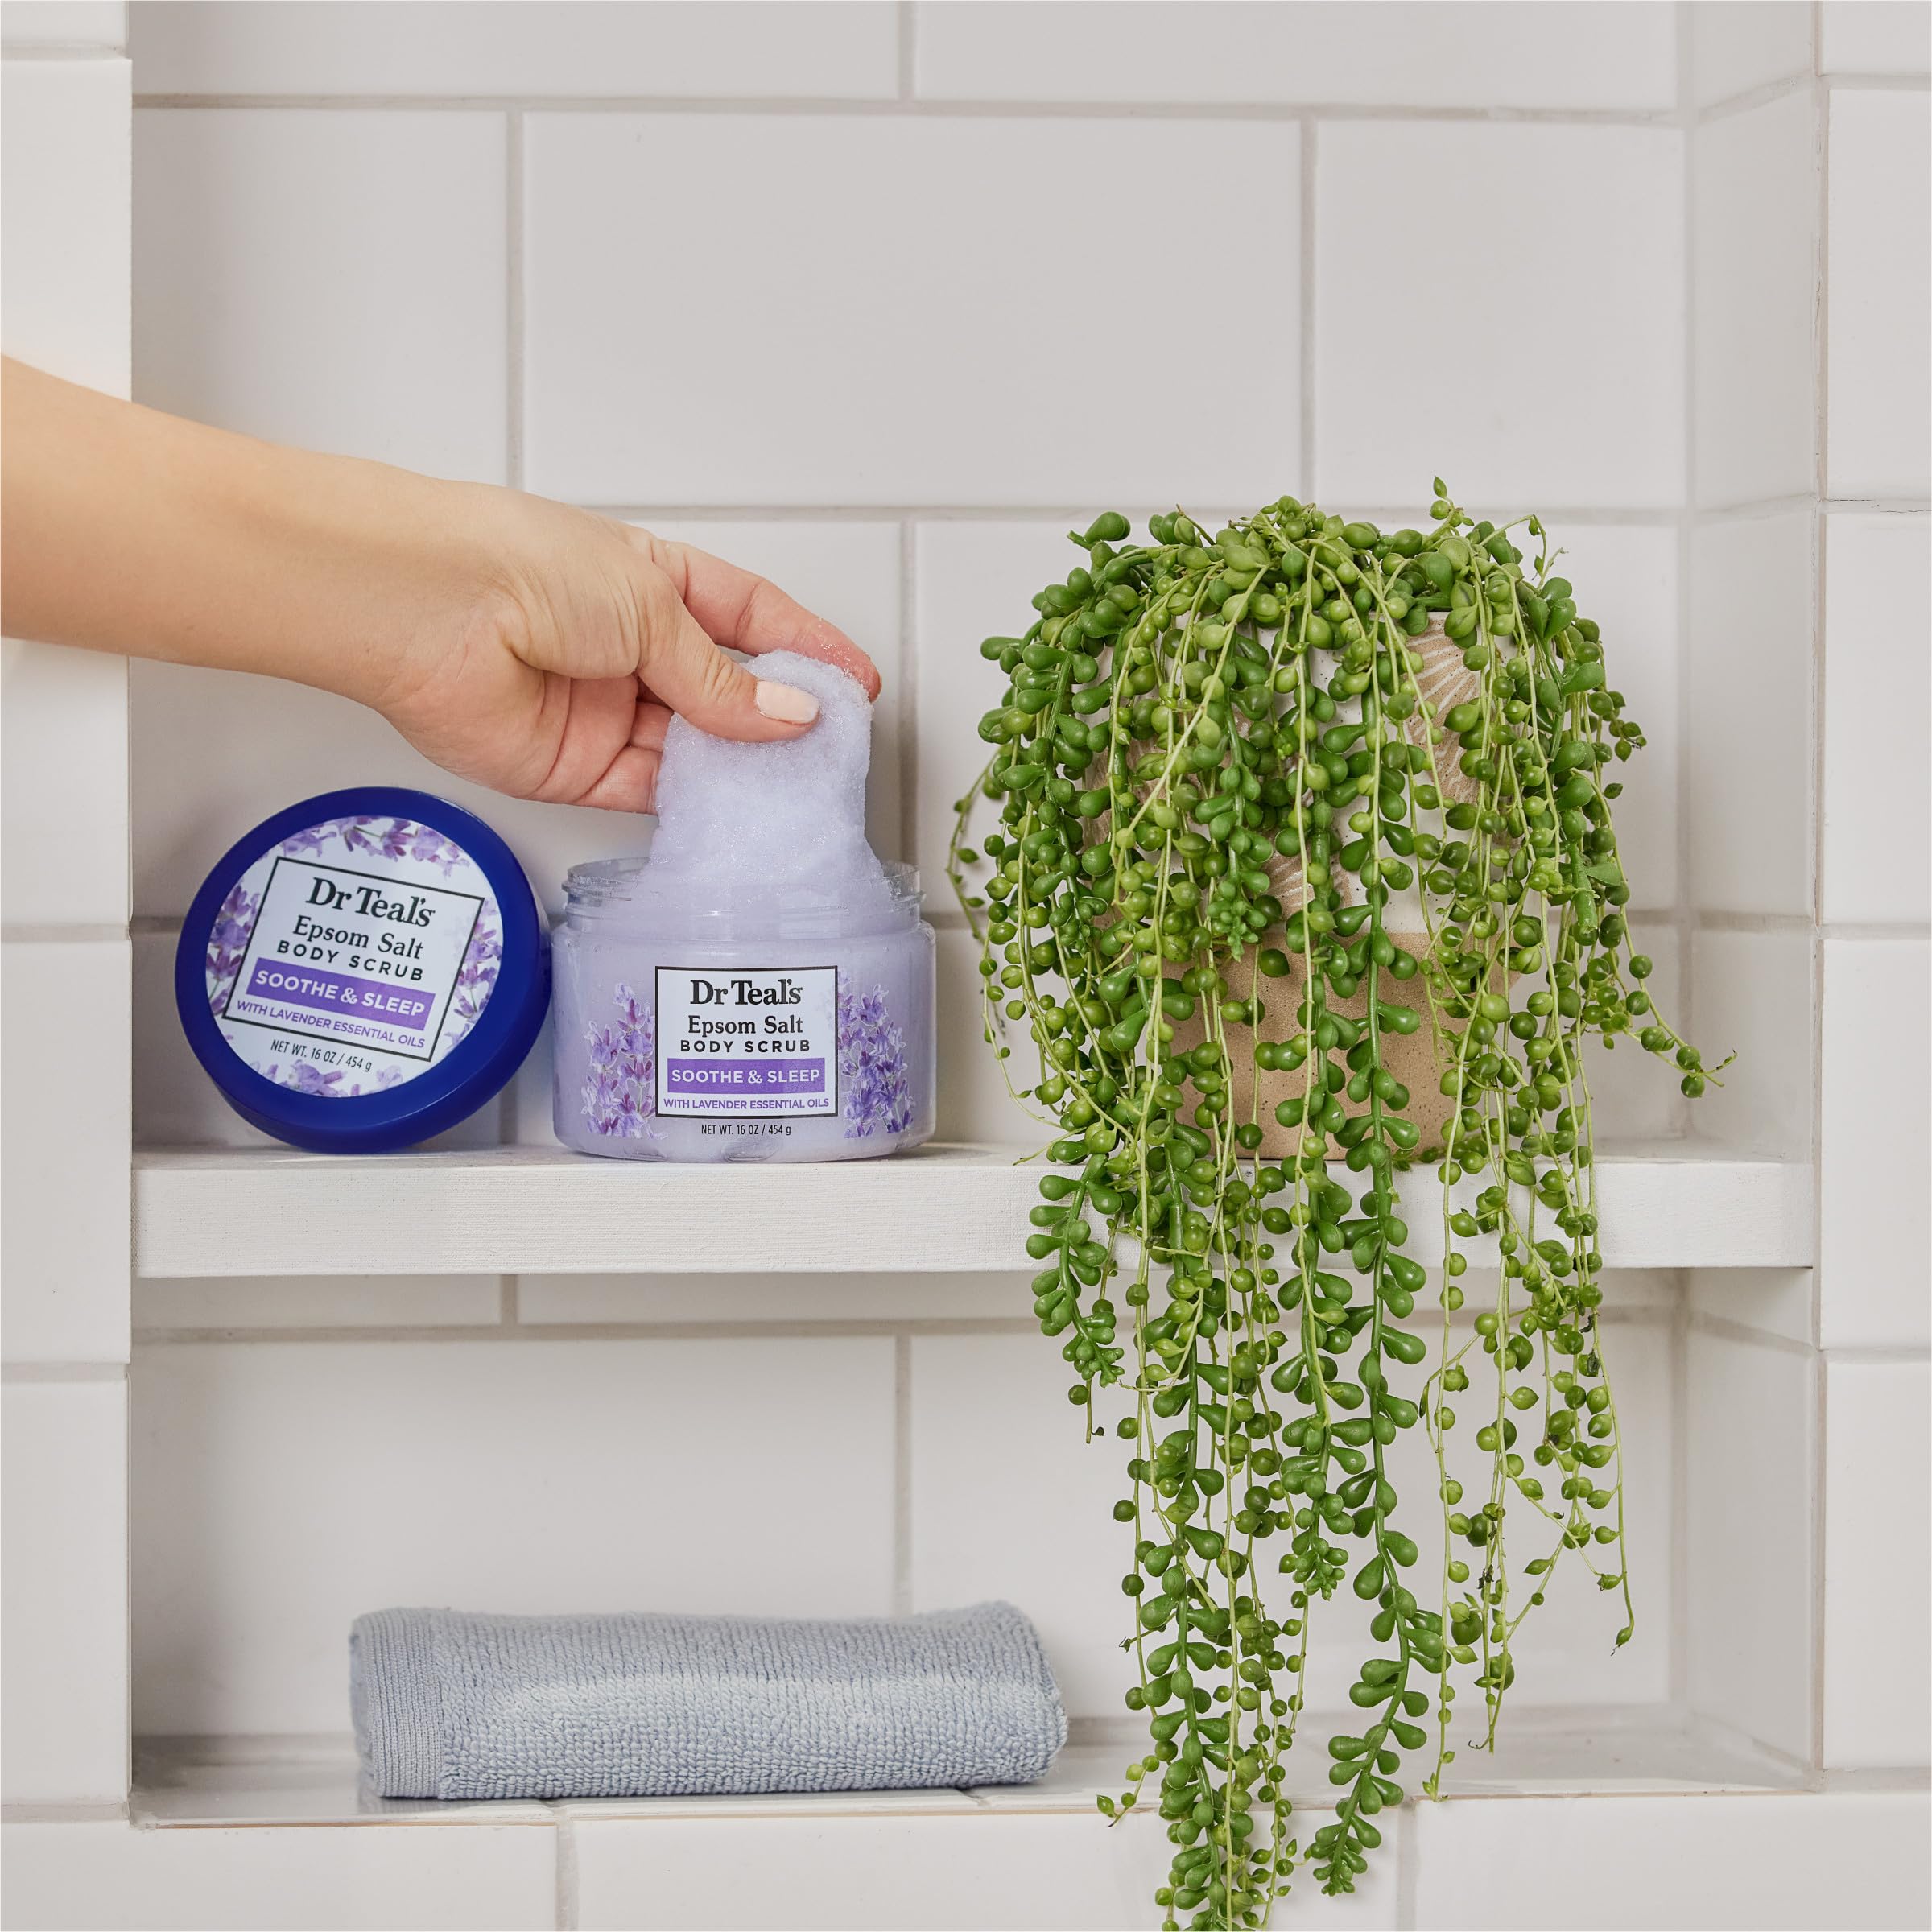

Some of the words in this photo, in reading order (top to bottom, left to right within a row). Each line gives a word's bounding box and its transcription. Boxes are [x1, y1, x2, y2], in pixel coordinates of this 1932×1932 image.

[305, 877, 353, 910] Dr
[353, 887, 436, 927] Teal's
[292, 914, 369, 947] Epsom
[377, 932, 423, 959] Salt
[278, 940, 339, 963] BODY
[349, 955, 423, 980] SCRUB
[255, 970, 338, 1001] SOOTHE
[340, 988, 358, 1005] &
[362, 992, 425, 1016] SLEEP
[690, 980, 728, 1005] Dr
[730, 979, 803, 1005] Teal's
[237, 1001, 267, 1018] WITH
[269, 1007, 331, 1029] LAVENDER
[333, 1020, 396, 1041] ESSENTIAL
[398, 1034, 425, 1048] OILS
[688, 1015, 756, 1037] Epsom
[764, 1015, 803, 1034] Salt
[270, 1039, 290, 1054] NET
[291, 1043, 308, 1058] WT.
[311, 1048, 321, 1060] 16
[323, 1051, 336, 1063] OZ
[337, 1053, 344, 1066] /
[345, 1055, 363, 1069] 454
[365, 1061, 371, 1072] g
[681, 1040, 734, 1053] BODY
[745, 1040, 810, 1053] SCRUB
[672, 1070, 743, 1084] SOOTHE
[748, 1070, 763, 1084] &
[767, 1070, 819, 1084] SLEEP
[664, 1098, 690, 1108] WITH
[692, 1100, 747, 1109] LAVENDER
[749, 1099, 805, 1109] ESSENTIAL
[807, 1098, 829, 1108] OILS
[701, 1125, 717, 1134] NET
[720, 1125, 733, 1134] WT.
[737, 1125, 745, 1135] 16
[748, 1125, 758, 1135] OZ
[761, 1124, 766, 1136] /
[768, 1125, 783, 1134] 454
[785, 1127, 791, 1136] g
